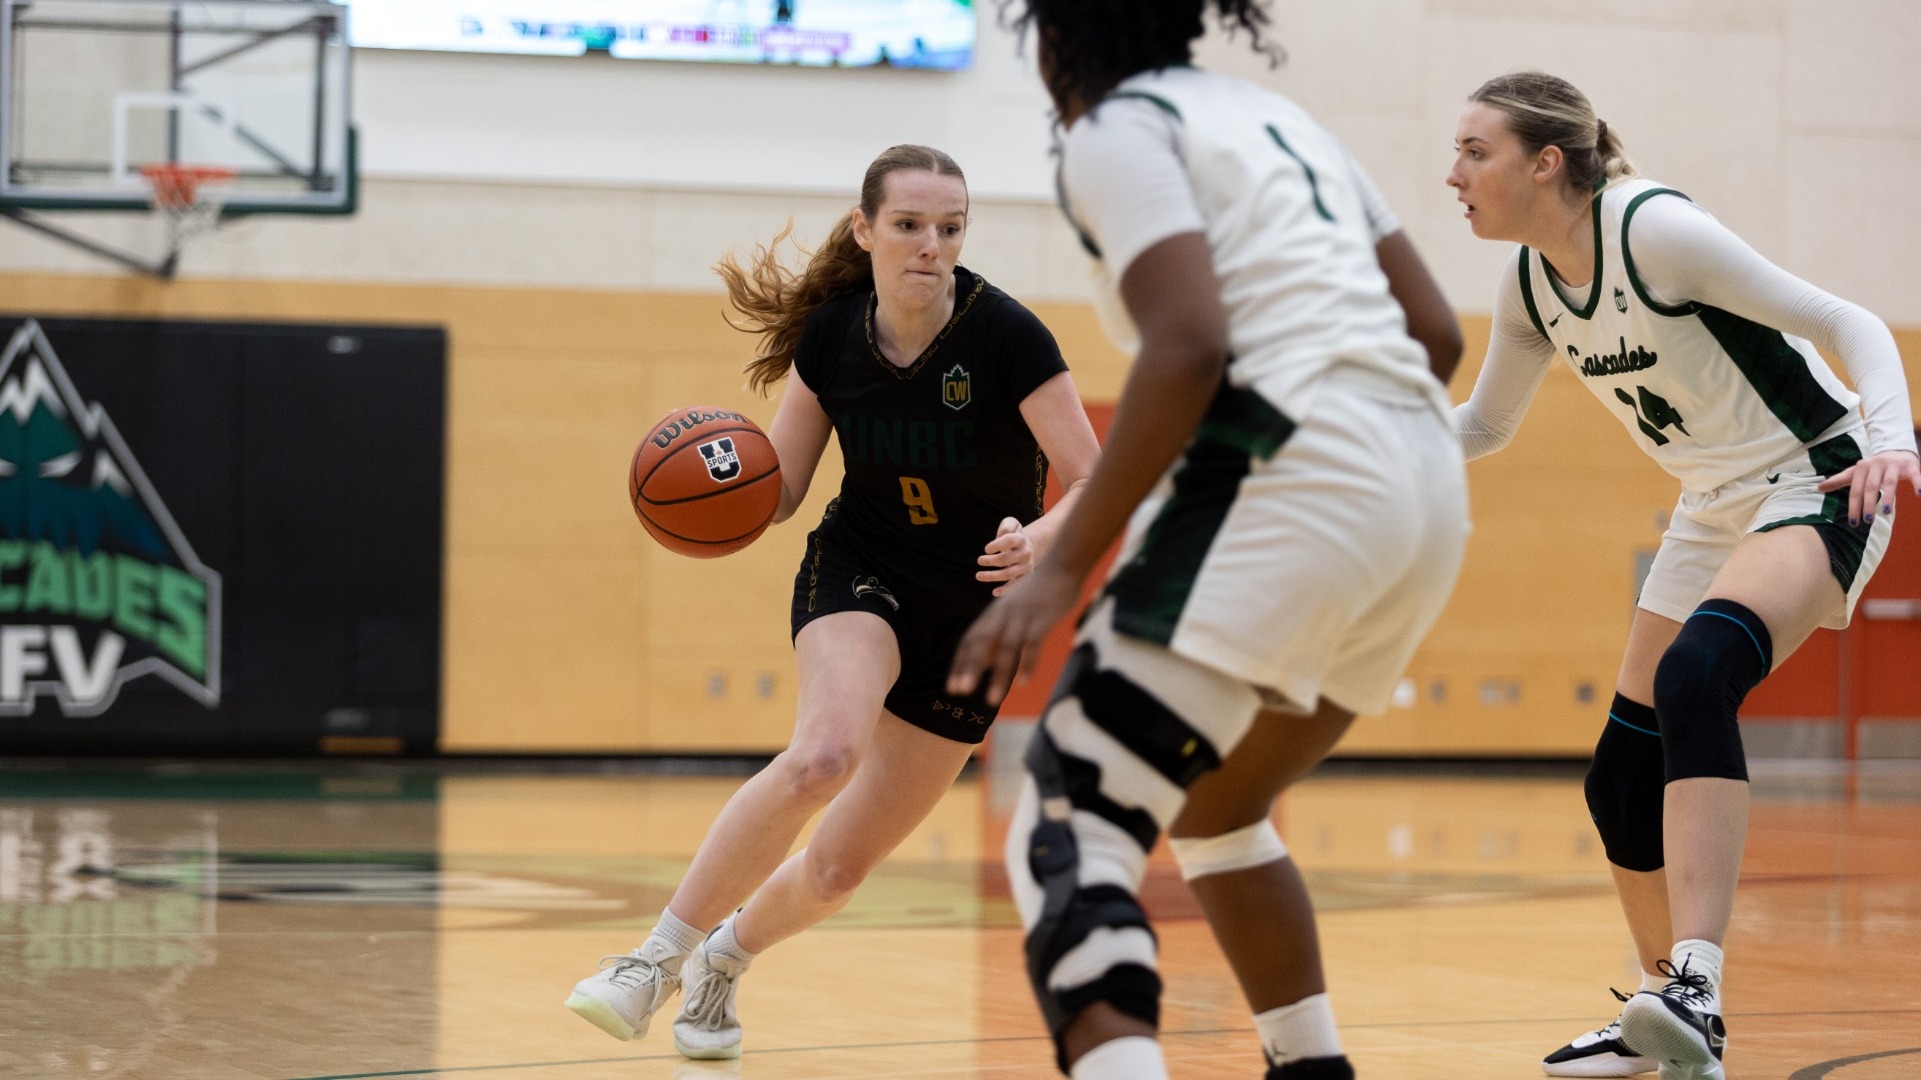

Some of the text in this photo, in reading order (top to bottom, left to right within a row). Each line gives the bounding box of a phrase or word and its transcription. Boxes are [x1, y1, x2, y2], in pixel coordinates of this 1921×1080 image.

[1567, 336, 1657, 377] Cascades
[946, 381, 966, 401] CW
[651, 411, 748, 449] Wilson
[1614, 385, 1692, 446] 14
[707, 452, 737, 468] SPORTS
[840, 414, 978, 469] UNBC
[898, 476, 940, 526] 9
